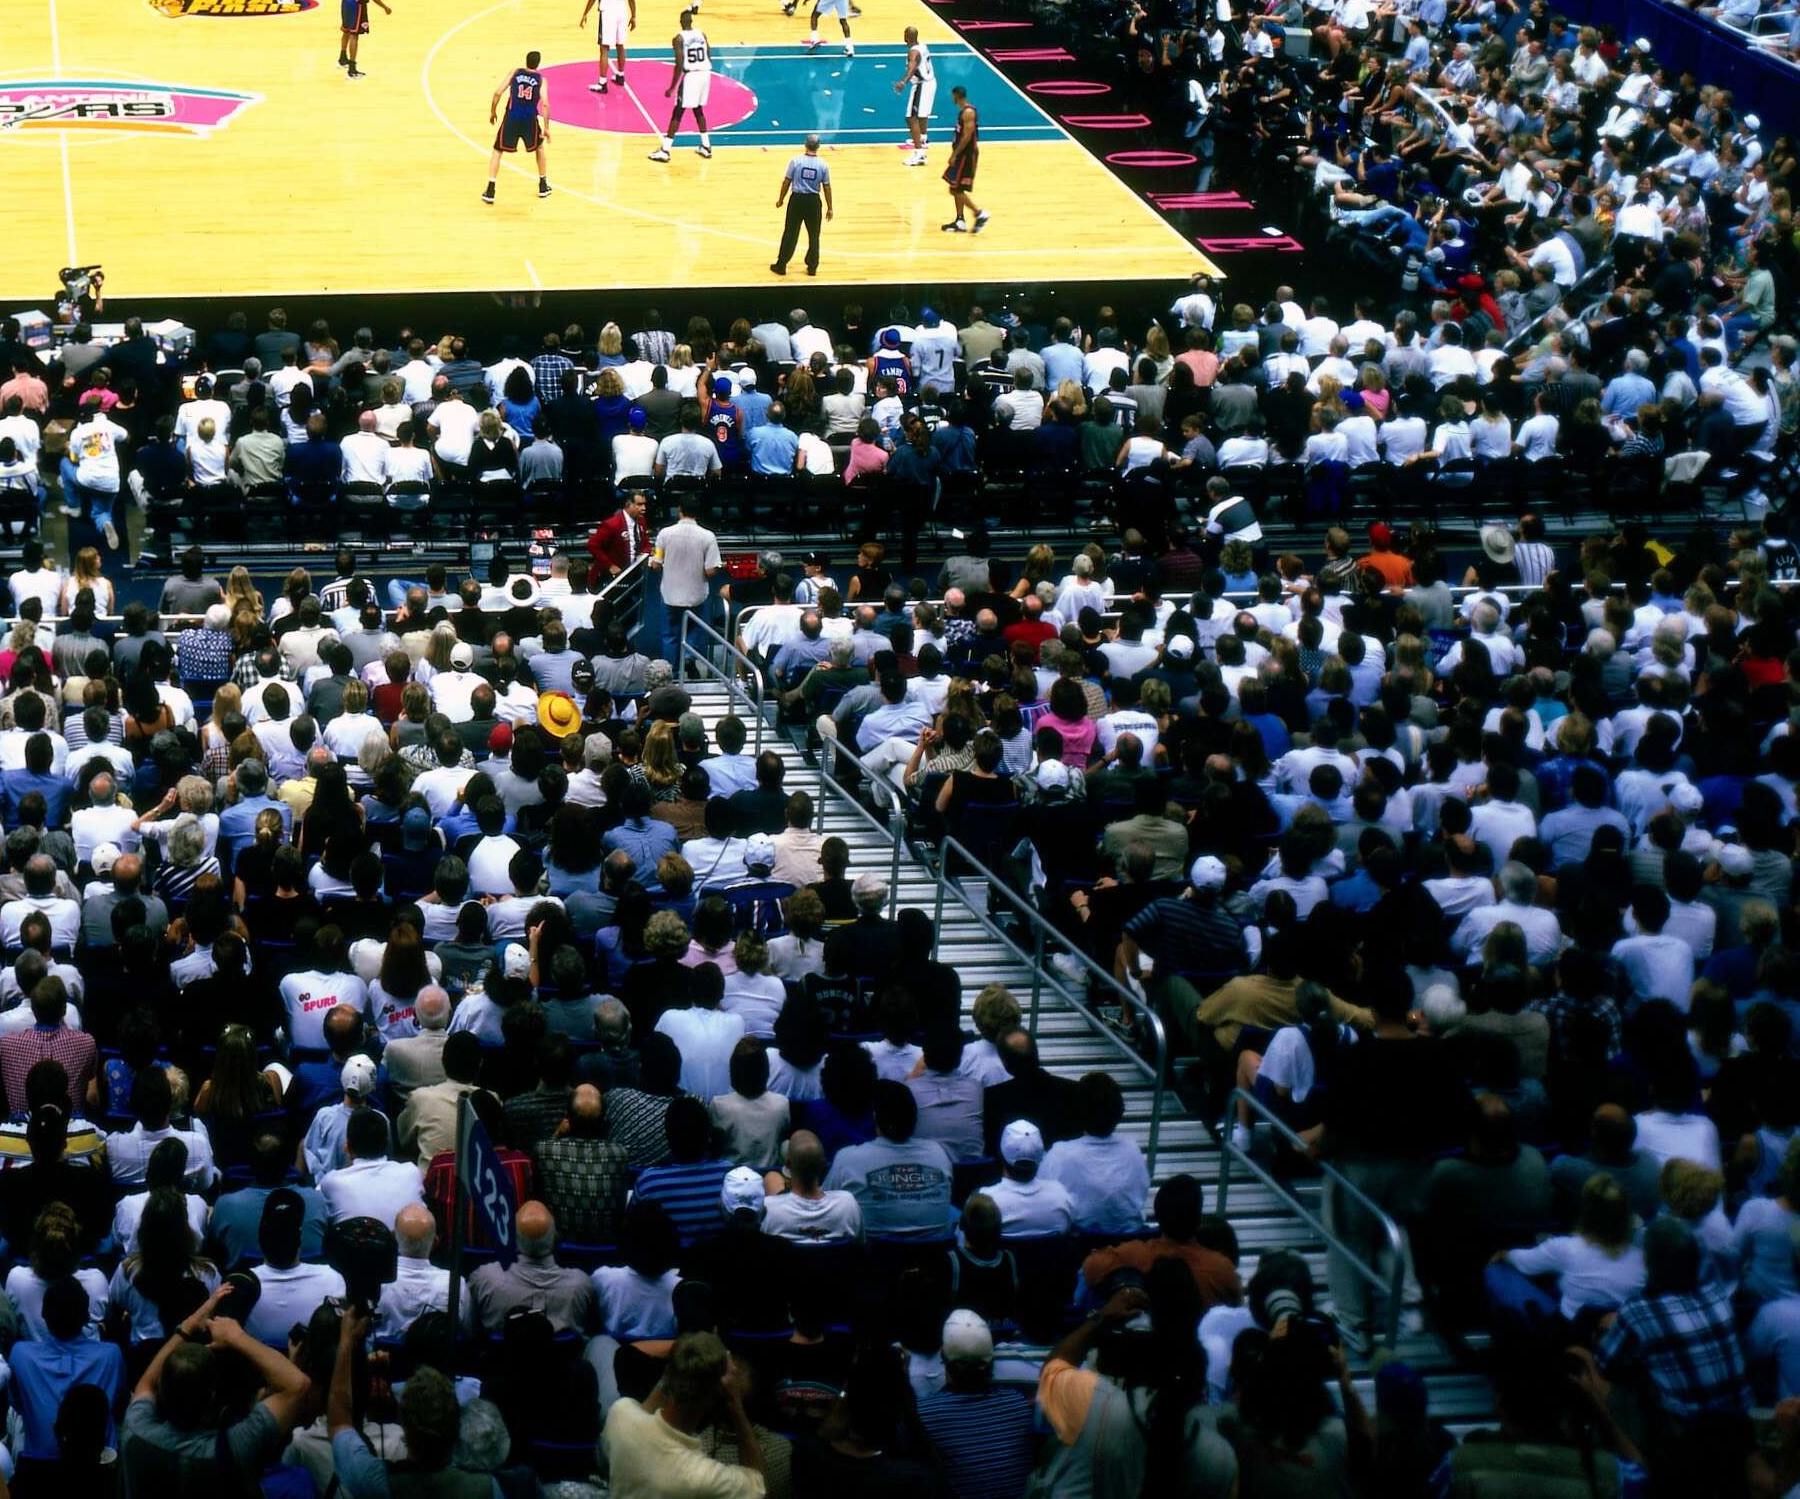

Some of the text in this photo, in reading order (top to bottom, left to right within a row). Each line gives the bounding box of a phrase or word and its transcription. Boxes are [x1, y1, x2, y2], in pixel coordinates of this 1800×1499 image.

[687, 47, 705, 63] 50
[517, 84, 533, 100] 14
[935, 350, 945, 369] 7
[716, 424, 728, 441] 8
[299, 993, 311, 1002] GO
[303, 995, 338, 1013] SPURS
[383, 1004, 395, 1014] GO
[473, 1141, 510, 1246] 123
